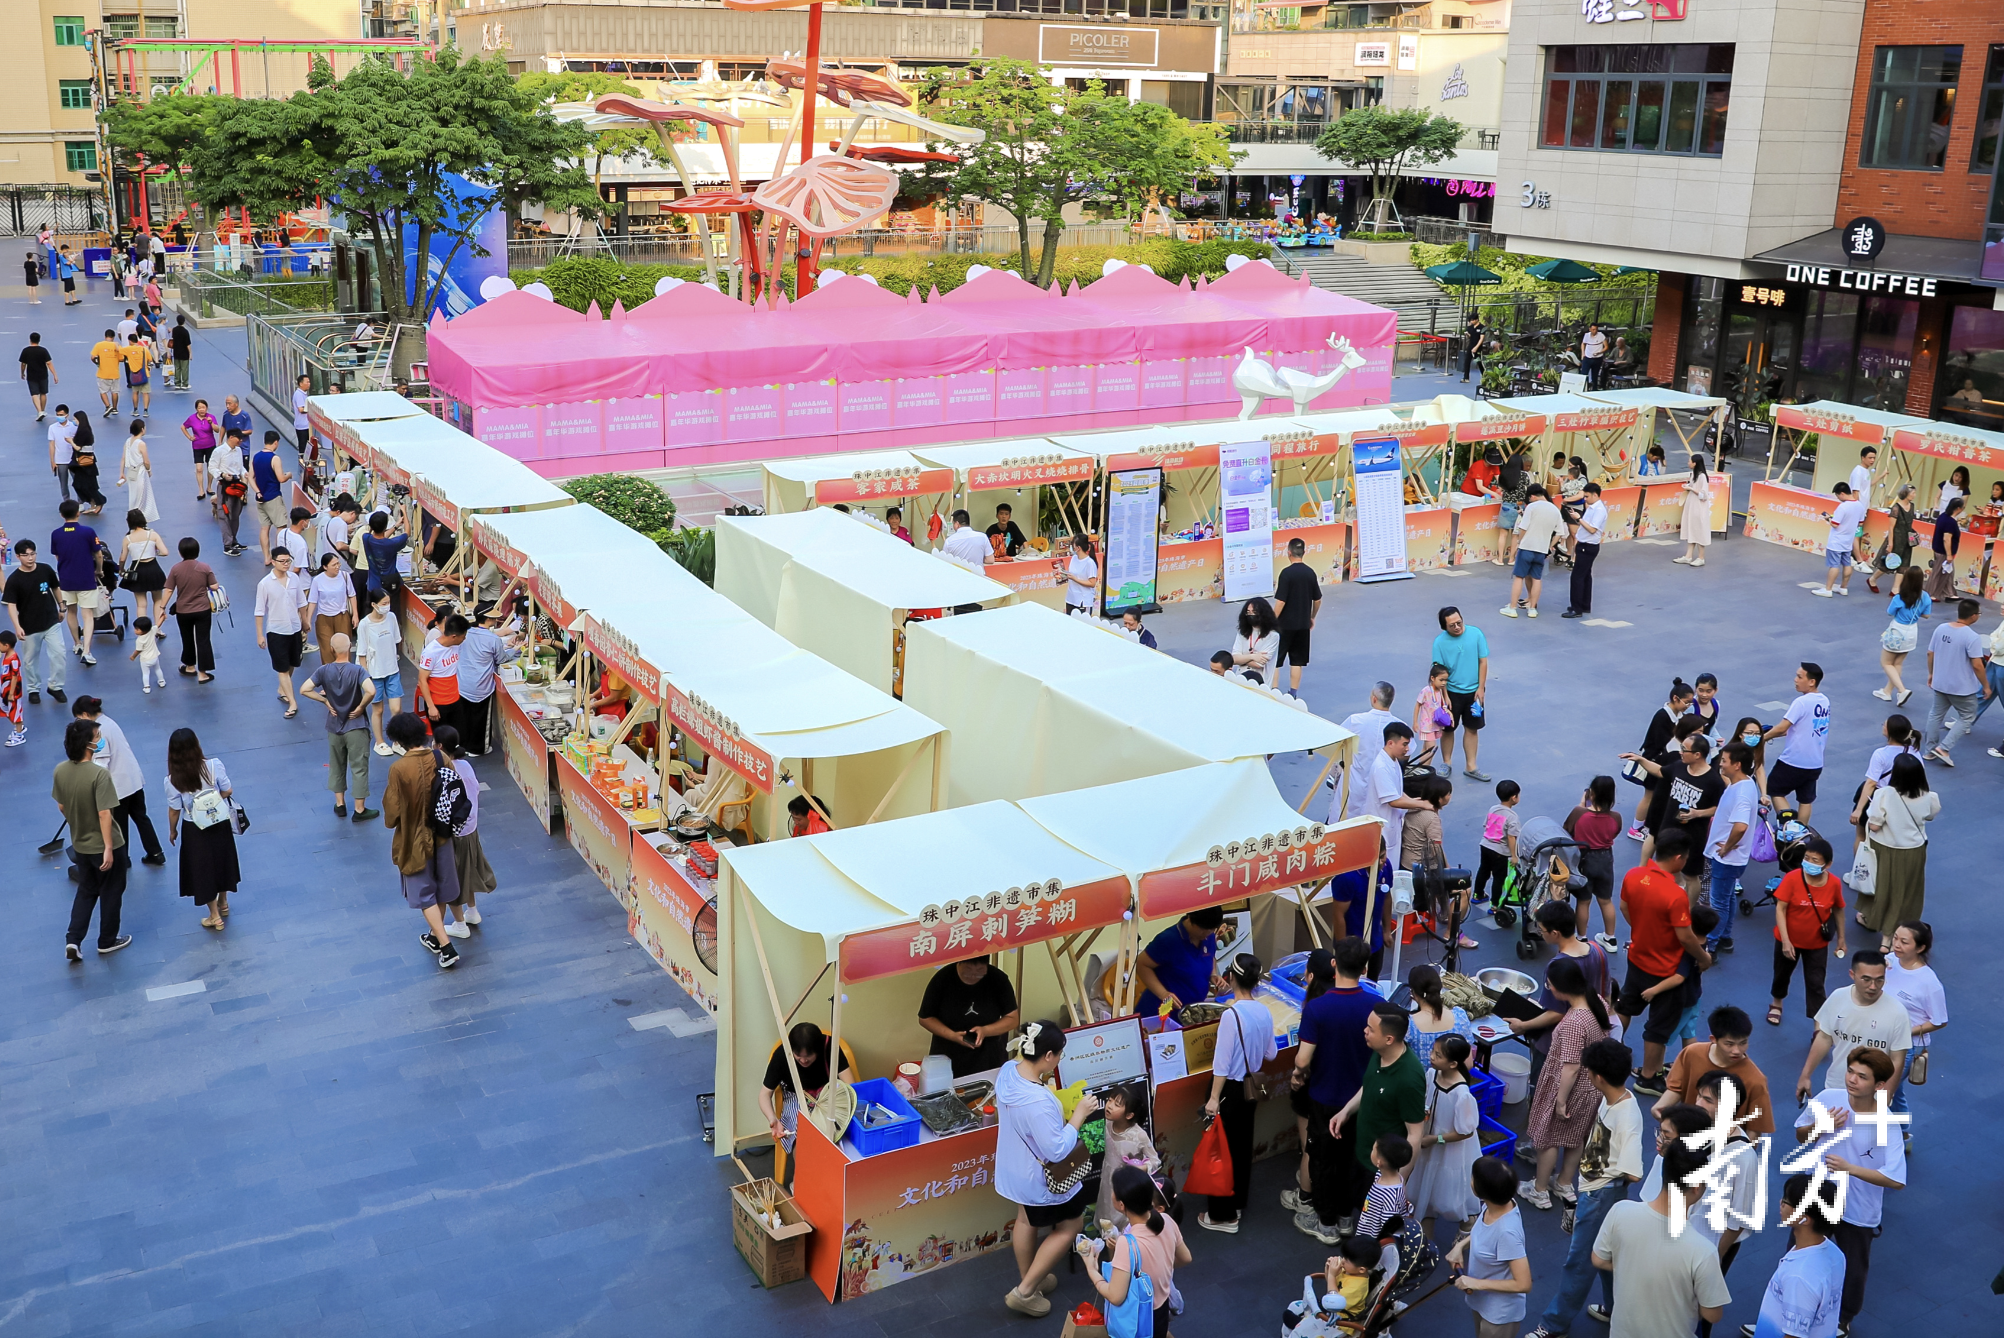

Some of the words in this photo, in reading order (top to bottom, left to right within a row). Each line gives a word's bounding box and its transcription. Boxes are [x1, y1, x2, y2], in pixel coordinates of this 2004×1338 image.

[1070, 33, 1129, 47] PICOLER
[1440, 80, 1469, 102] Santos
[1520, 180, 1551, 209] 3栋
[1786, 264, 1831, 286] ONE
[1839, 270, 1937, 297] COFFEE
[1740, 285, 1785, 307] 壹号啡
[953, 387, 987, 395] MAMA&MIA
[848, 396, 883, 404] MAMA&MIA
[897, 398, 940, 408] 嘉年华游戏摊位
[675, 408, 714, 417] MAMA&MIA
[734, 404, 772, 412] MAMA&MIA
[787, 407, 833, 416] 嘉年华游戏摊位
[843, 403, 887, 413] 嘉年华游戏摊位
[550, 418, 592, 427] MAMA&MIA
[613, 413, 653, 422] MAMA&MIA
[671, 416, 719, 426] 嘉年华游戏摊位
[730, 411, 777, 421] 嘉年华游戏摊位
[486, 423, 529, 432] MAMA&MIA
[546, 426, 597, 436] 嘉年华游戏摊位
[609, 421, 658, 431] 嘉年华游戏摊位
[1803, 417, 1853, 435] 三灶剪纸
[481, 430, 534, 441] 嘉年华游戏摊位
[1271, 440, 1319, 455] 同程旅行
[1918, 439, 1991, 463] 罗氏柑普茶
[854, 466, 920, 480] 珠中江非遗市集
[975, 463, 1089, 485] 大赤坎明火叉烧烧排骨
[855, 478, 920, 496] 客家咸茶
[689, 692, 740, 737] 珠中江非遗市集
[1671, 780, 1702, 801] LINKIN
[1670, 788, 1698, 809] PARK
[1209, 825, 1324, 864] 珠中江非遗市集
[1197, 842, 1337, 896] 斗门咸肉粽
[922, 880, 1061, 923] 珠中江非遗市集
[909, 899, 1077, 957] 南屏刺笋糊
[1851, 1035, 1863, 1044] OF
[1867, 1039, 1887, 1049] GOD
[896, 1167, 996, 1209] 文化和自
